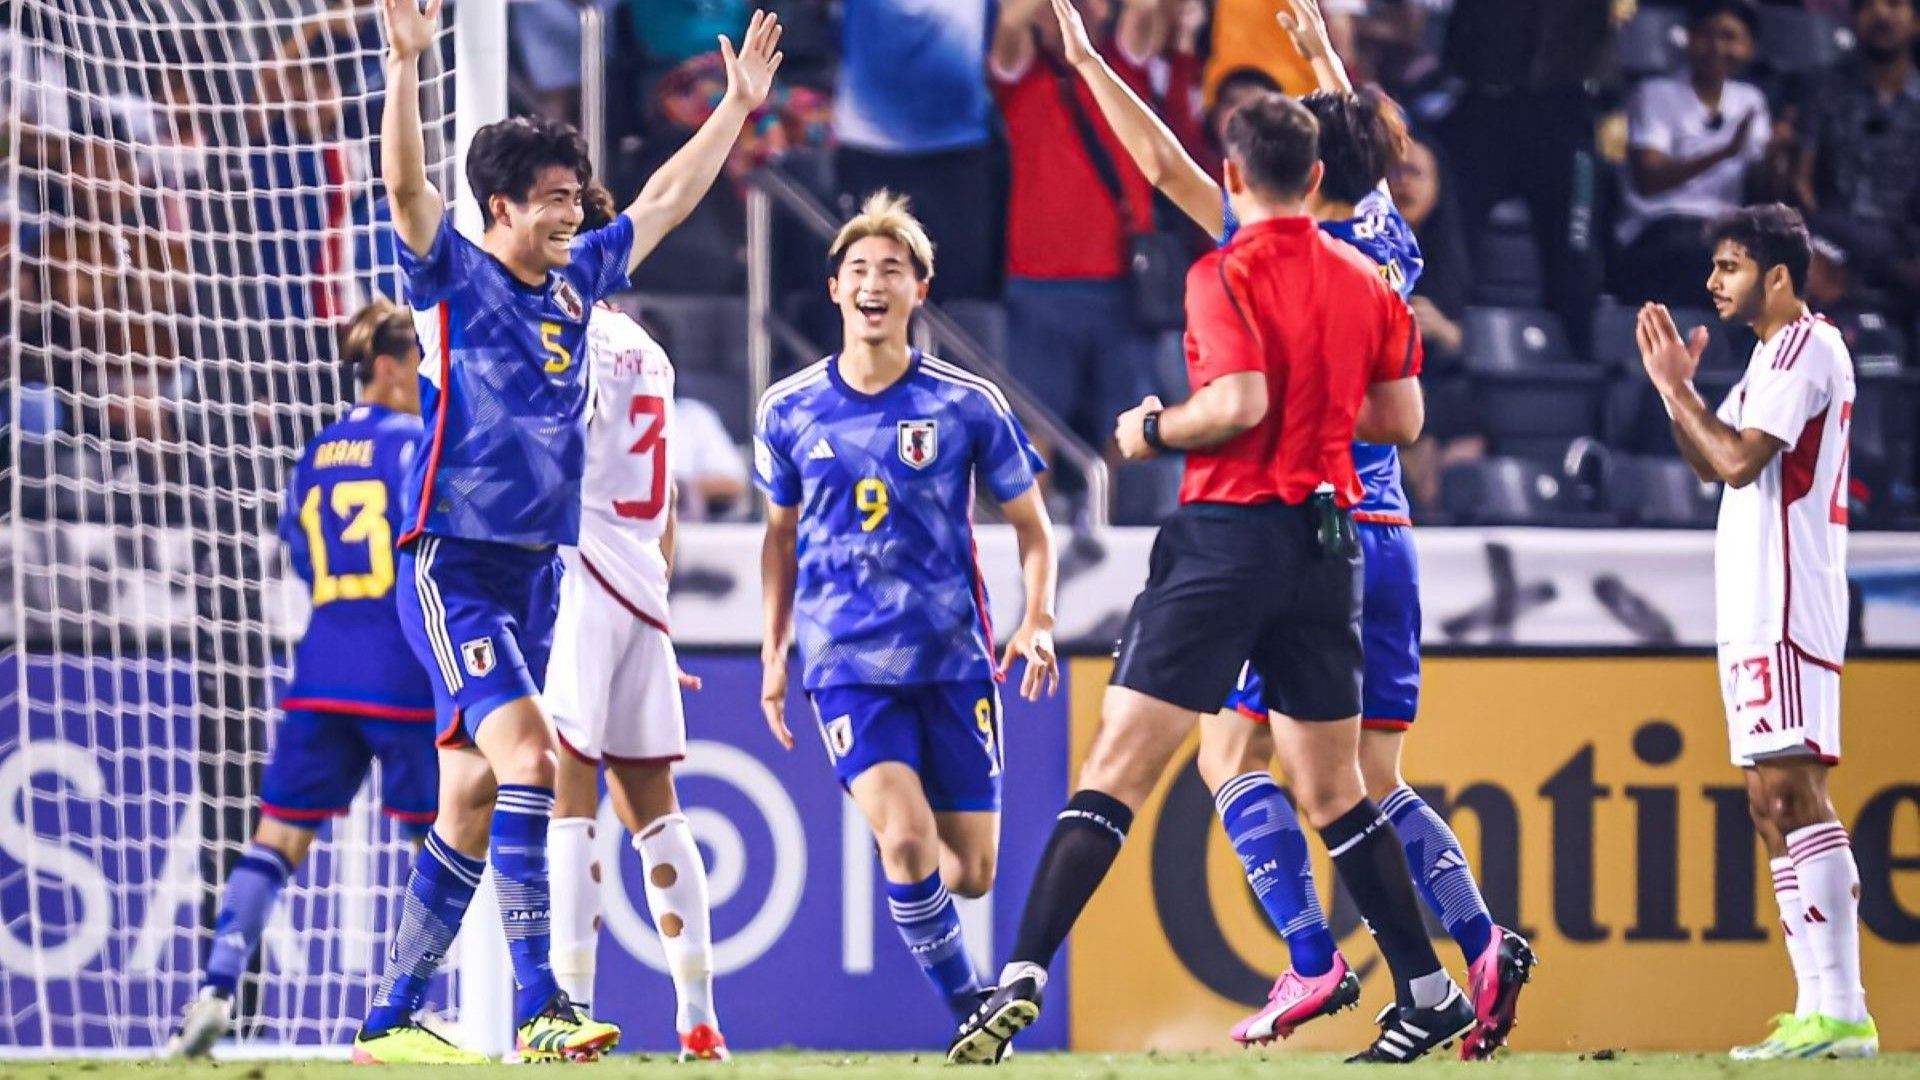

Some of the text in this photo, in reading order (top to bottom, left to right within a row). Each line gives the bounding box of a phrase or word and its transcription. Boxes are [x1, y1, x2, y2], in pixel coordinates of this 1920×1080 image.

[540, 321, 572, 374] 5
[612, 394, 667, 520] 3
[855, 478, 889, 532] 9
[300, 479, 394, 607] 13
[975, 697, 994, 754] 9
[509, 910, 551, 921] JAPA
